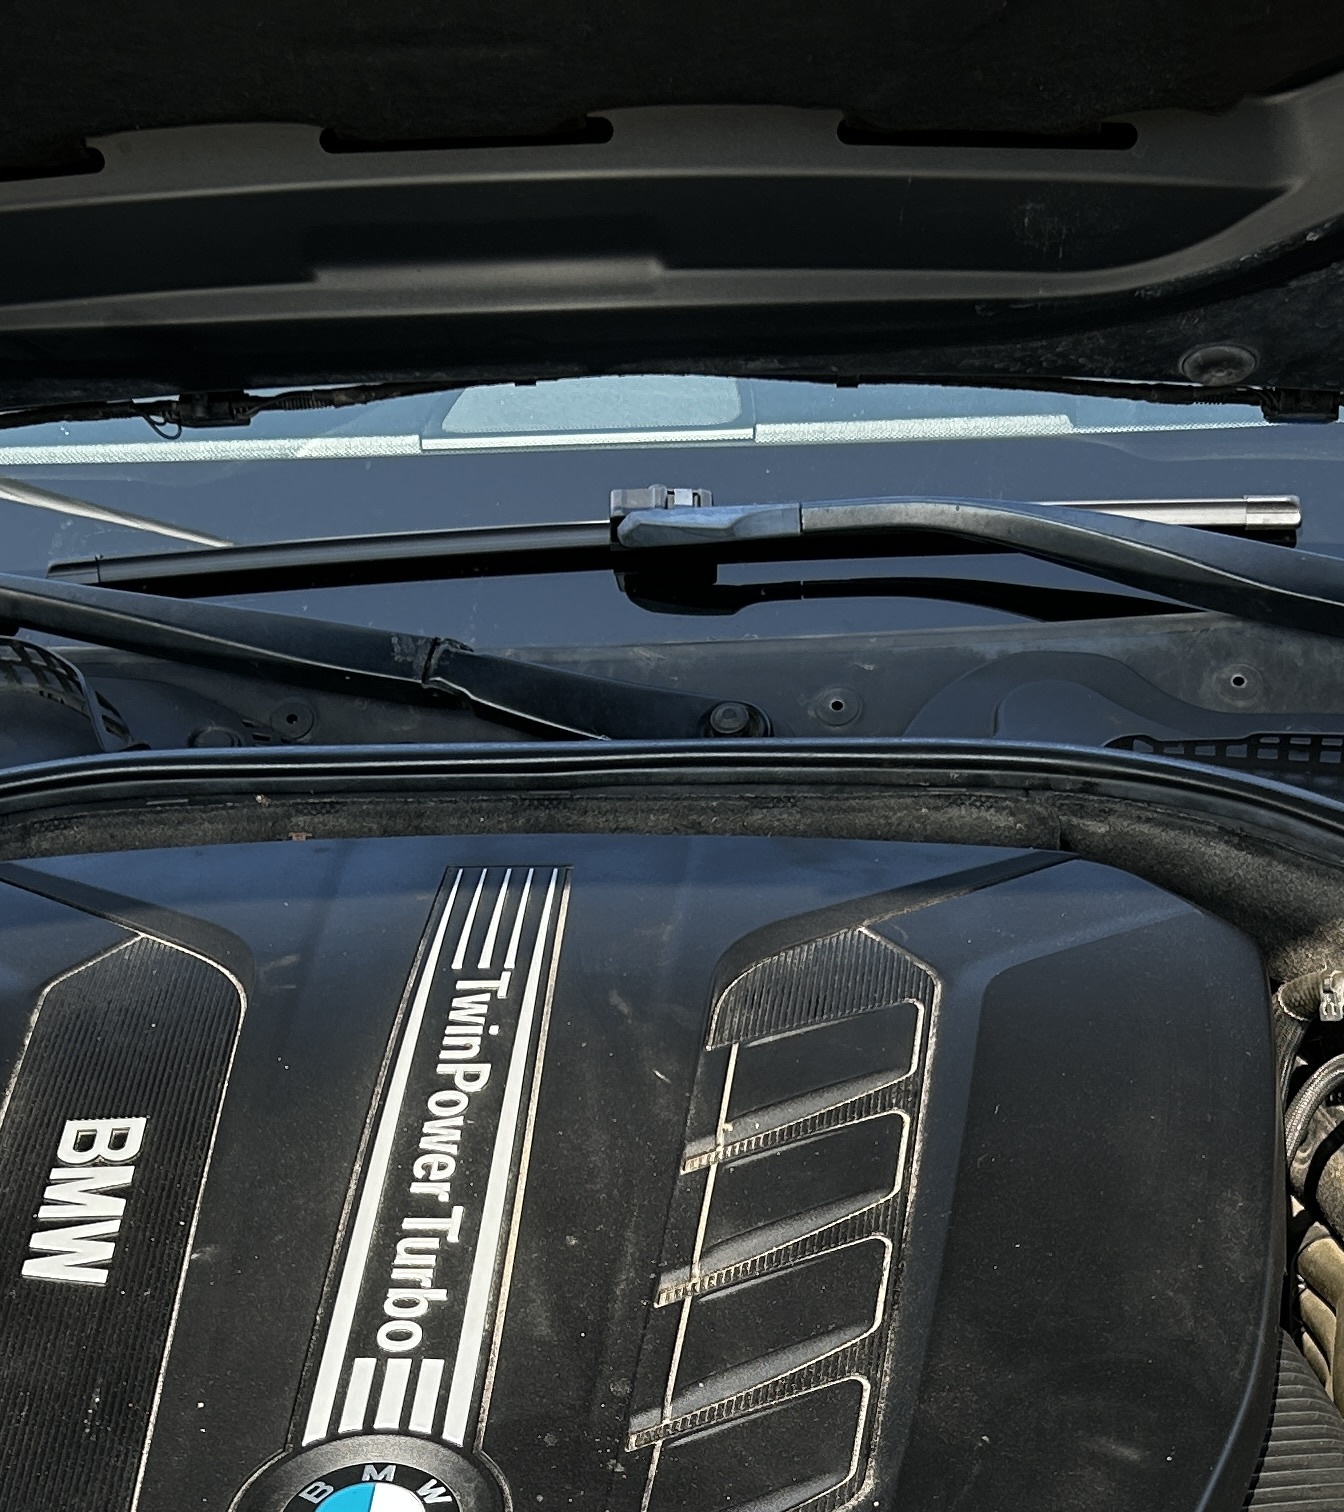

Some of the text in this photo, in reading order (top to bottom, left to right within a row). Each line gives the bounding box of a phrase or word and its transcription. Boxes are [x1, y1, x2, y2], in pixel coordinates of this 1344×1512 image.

[22, 1116, 148, 1285] BMW
[376, 970, 512, 1352] TwinPower Turbo
[298, 1464, 453, 1505] BMW
